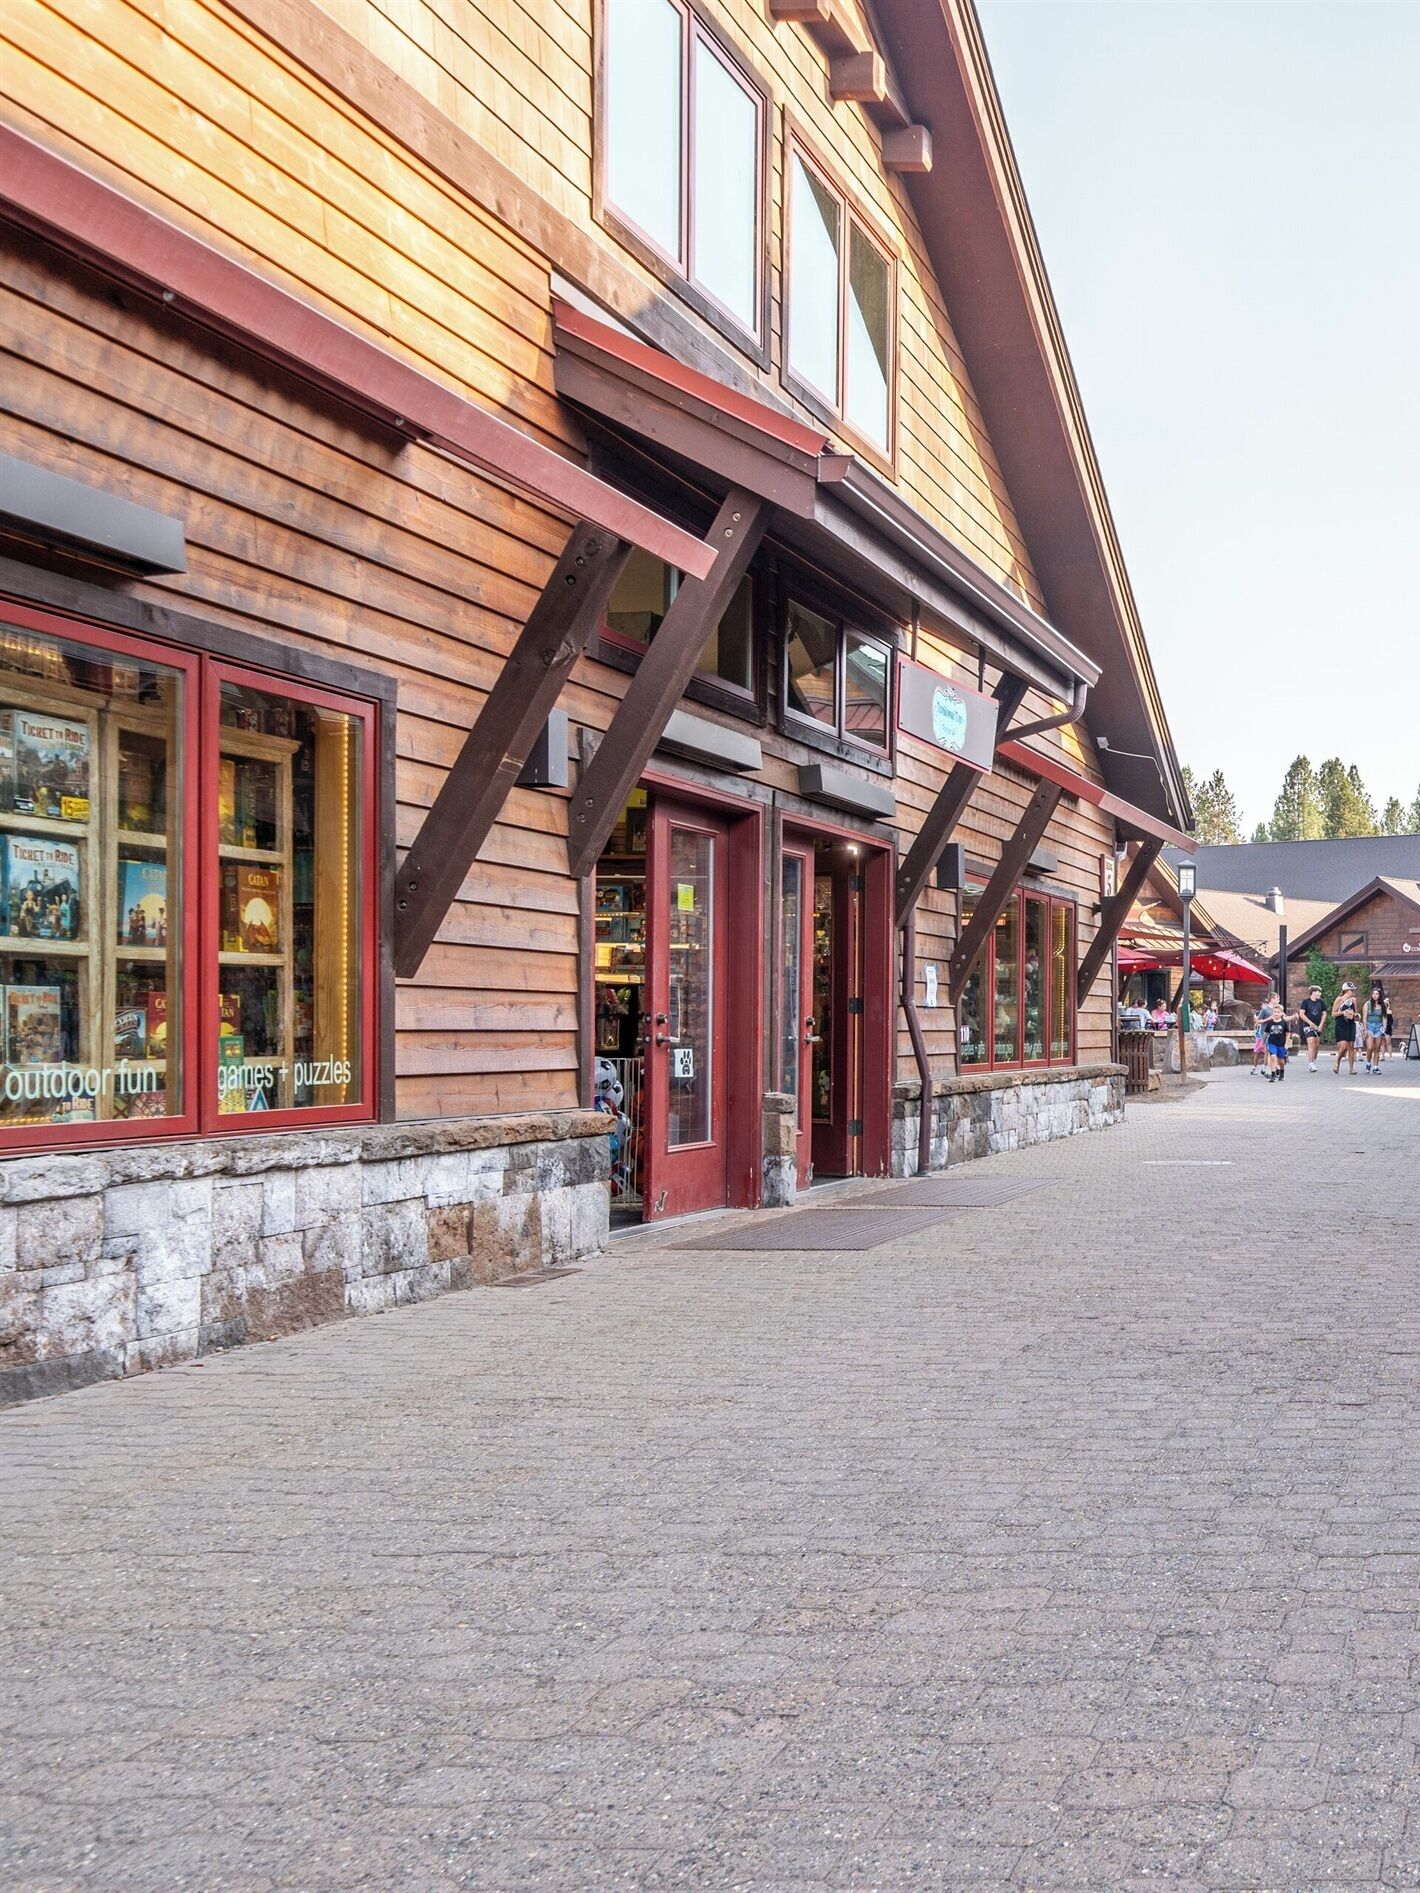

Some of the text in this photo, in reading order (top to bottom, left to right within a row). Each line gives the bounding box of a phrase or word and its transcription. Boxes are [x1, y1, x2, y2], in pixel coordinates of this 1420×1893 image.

[13, 844, 45, 862] TICKET
[54, 849, 75, 866] RIDE
[248, 873, 269, 888] CATAN
[5, 1058, 157, 1101] outdoor fun
[218, 1054, 351, 1099] games + puzzles
[72, 1096, 95, 1111] RIDE
